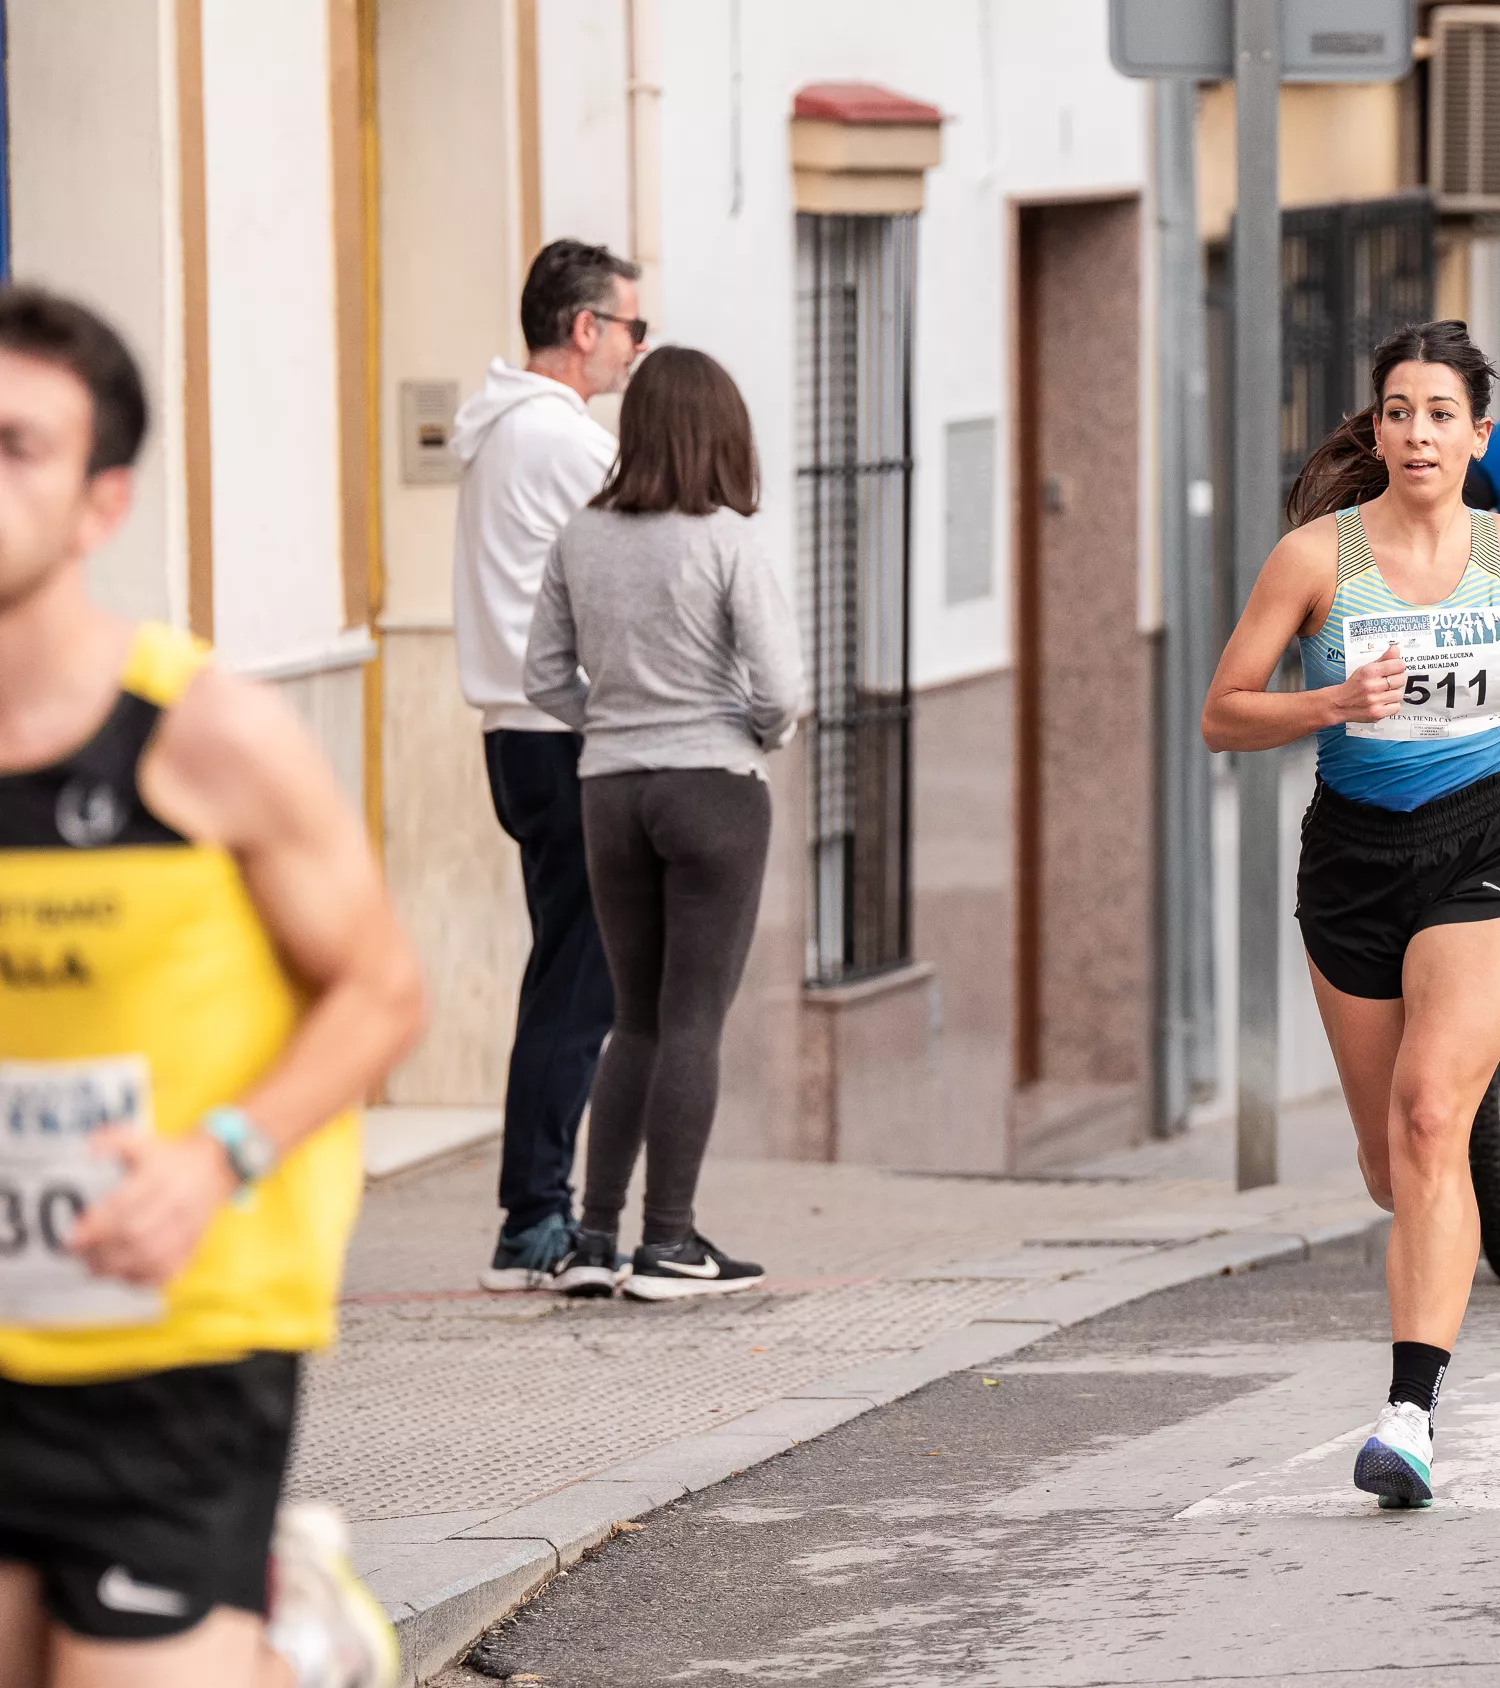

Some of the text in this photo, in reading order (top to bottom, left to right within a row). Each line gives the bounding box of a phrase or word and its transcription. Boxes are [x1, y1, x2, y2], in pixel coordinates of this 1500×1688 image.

[1349, 615, 1431, 630] CIRCUITO PROVINCIAL DE
[1432, 613, 1473, 630] 2024
[1349, 623, 1432, 637] CARRERAS POPULARES
[1417, 654, 1440, 662] CIUDAD
[1450, 651, 1474, 659] LUCENA
[1428, 661, 1459, 670] IGUALDAD
[1403, 669, 1487, 708] 511
[1389, 713, 1411, 722] ELENA
[1412, 715, 1438, 723] TIENDA
